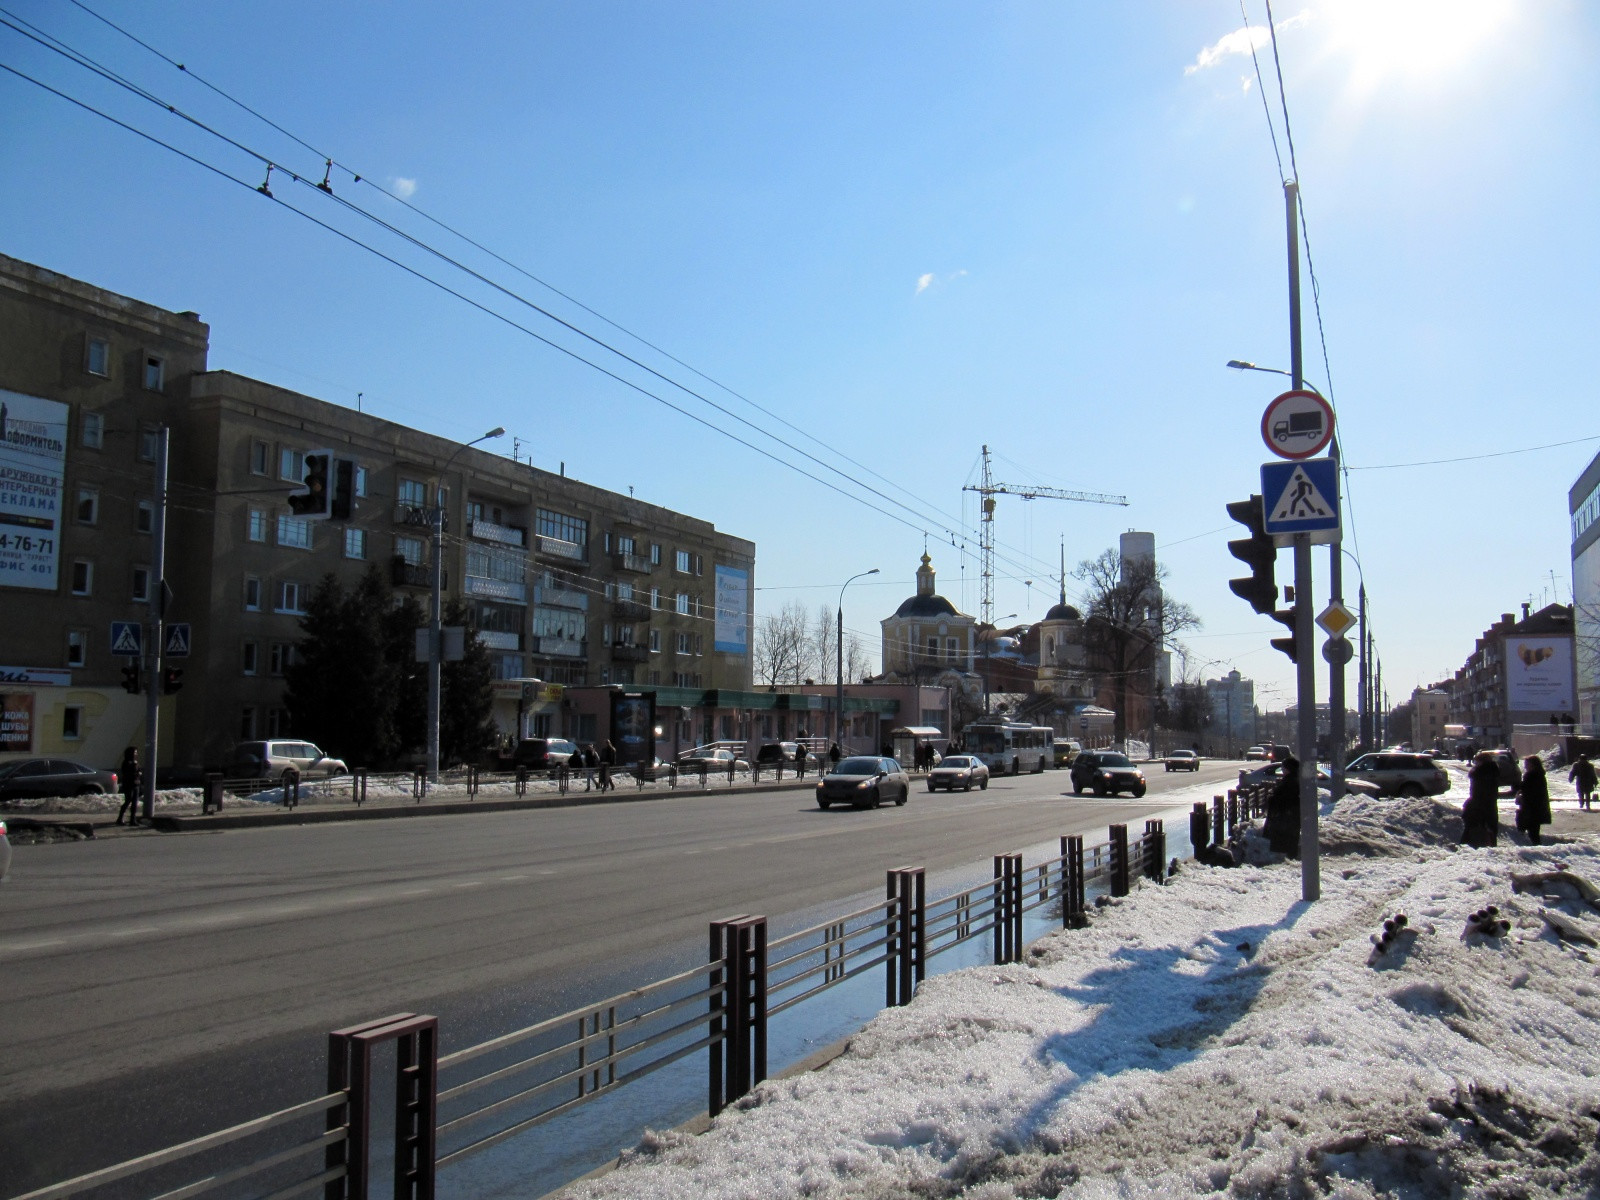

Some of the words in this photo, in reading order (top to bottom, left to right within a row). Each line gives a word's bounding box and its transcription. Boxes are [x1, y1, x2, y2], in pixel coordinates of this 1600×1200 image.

[7, 430, 63, 452] оформитель
[1, 492, 55, 511] ЕКЛАМА
[0, 533, 53, 554] 4-76-71
[31, 563, 52, 574] 401
[1, 721, 29, 731] ШУБЫ
[0, 733, 29, 742] ЛЕНКИ
